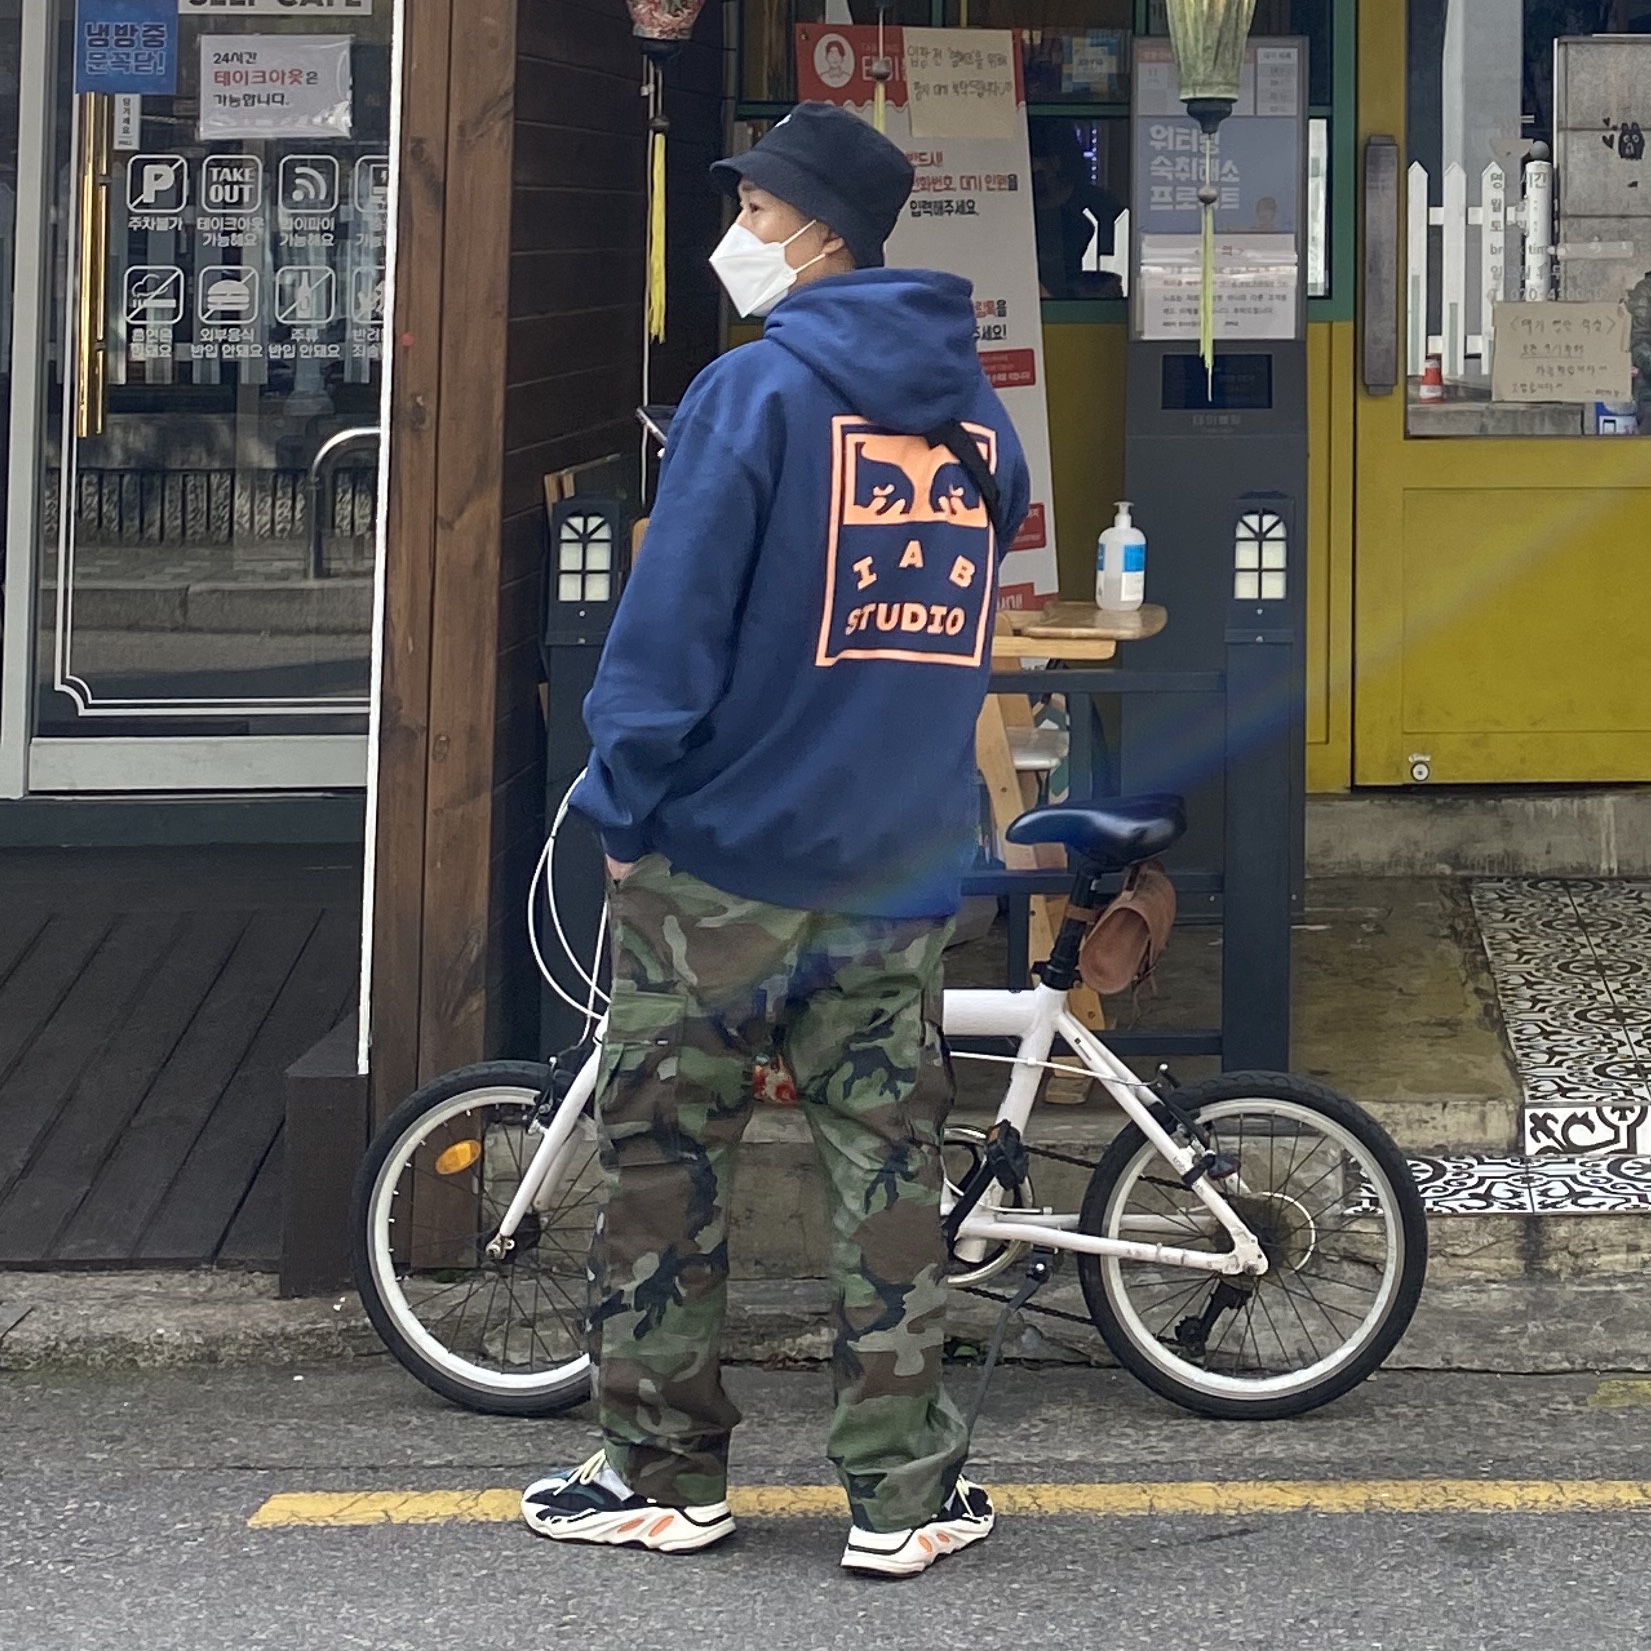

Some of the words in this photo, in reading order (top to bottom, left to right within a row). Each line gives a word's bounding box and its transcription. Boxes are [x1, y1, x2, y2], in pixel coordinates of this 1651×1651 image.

[85, 22, 167, 49] 냉방중
[213, 52, 257, 65] 24시간
[214, 69, 319, 87] 테이크아웃은
[213, 93, 290, 108] 가능합니다.
[210, 167, 255, 182] TAKE
[1149, 155, 1240, 182] 숙취해소
[209, 184, 254, 203] OUT
[1150, 186, 1240, 211] 프로트
[128, 217, 183, 231] 주차불가
[197, 217, 265, 232] 테이크아웃
[203, 233, 258, 248] 가능해요
[279, 233, 335, 247] 가능해요
[200, 328, 255, 342] 외부음식
[190, 344, 218, 359] 반입
[268, 344, 296, 359] 반입
[845, 603, 965, 636] STUDIO
